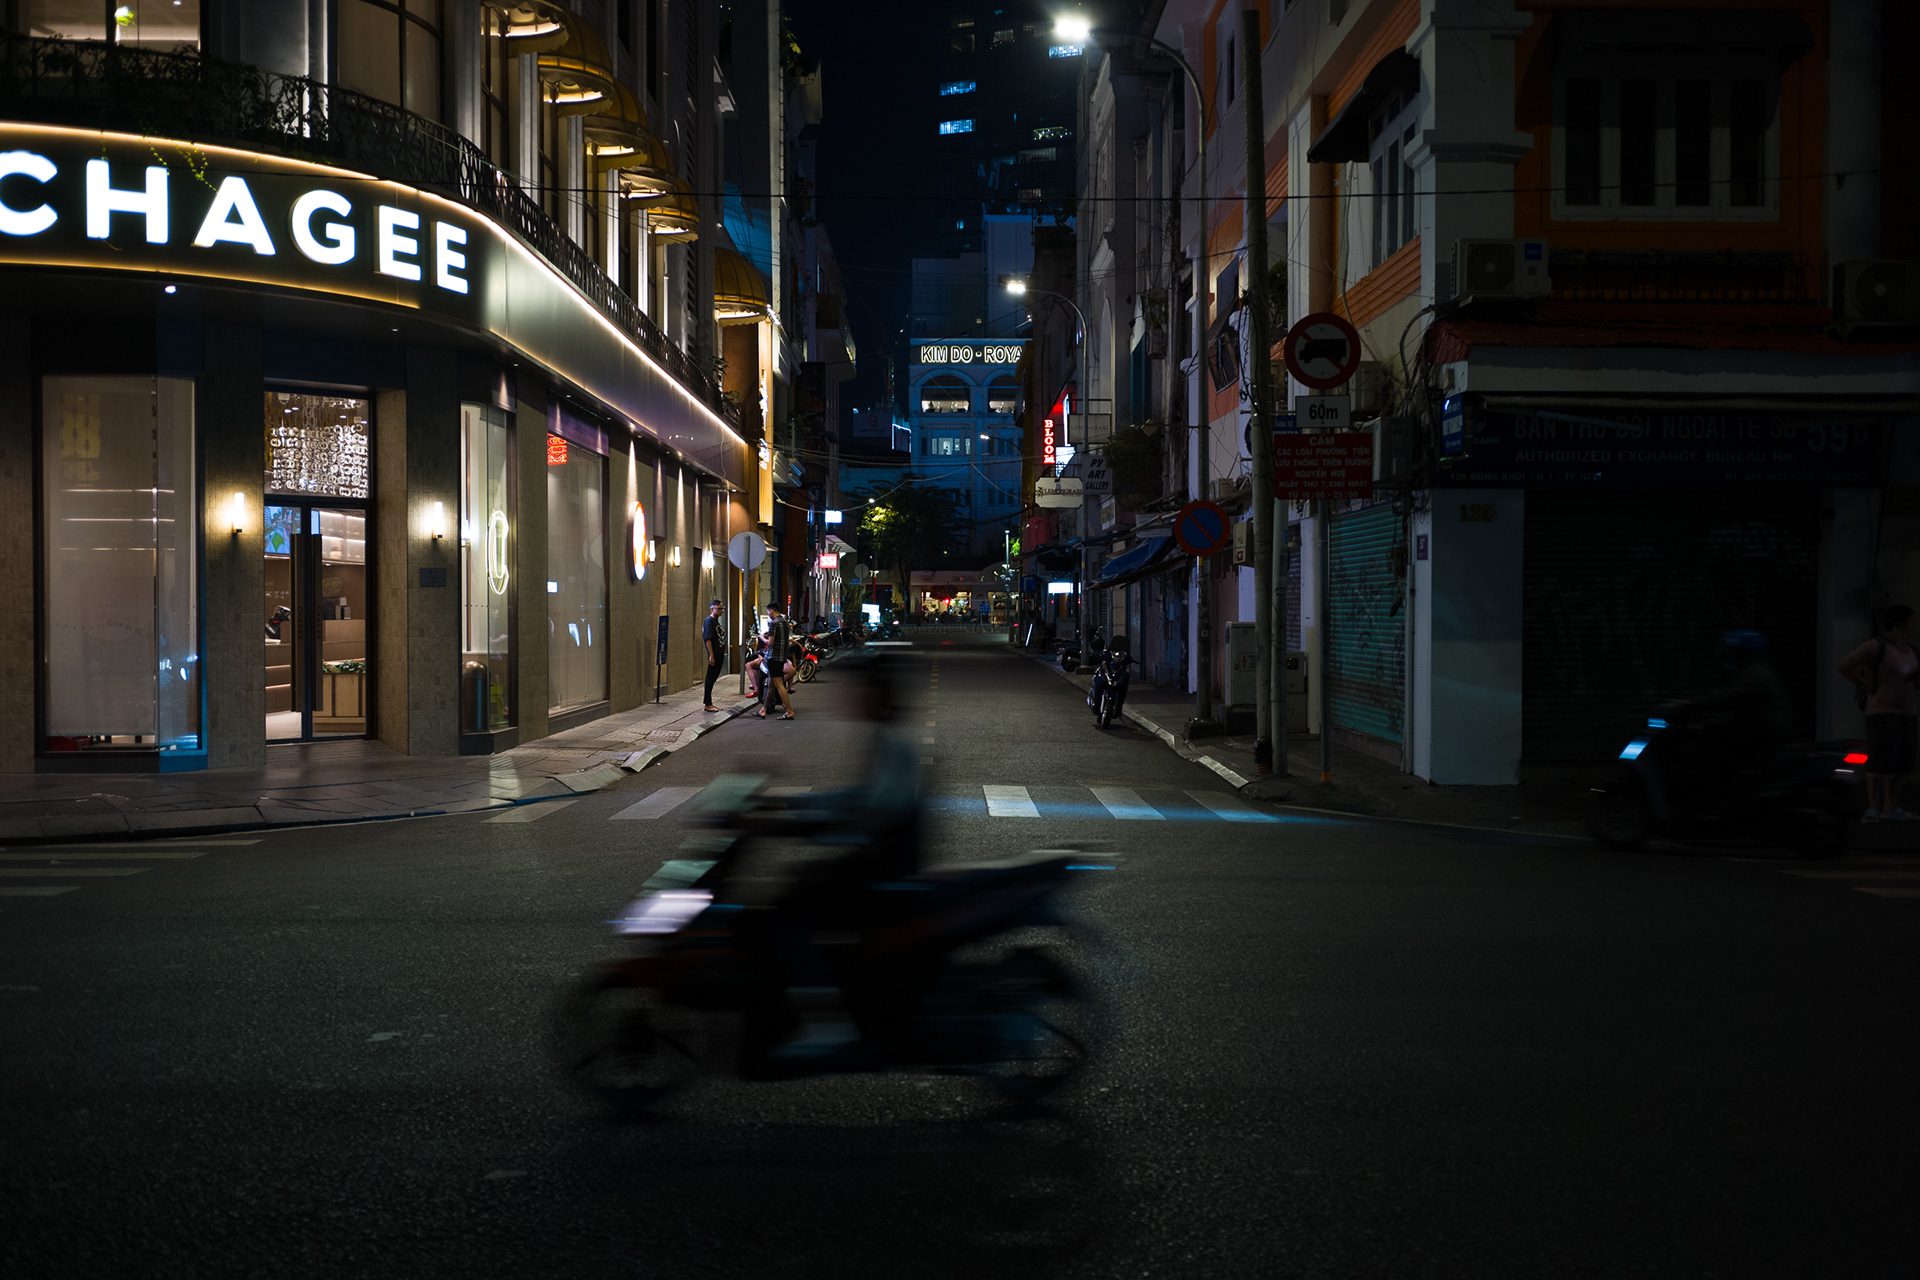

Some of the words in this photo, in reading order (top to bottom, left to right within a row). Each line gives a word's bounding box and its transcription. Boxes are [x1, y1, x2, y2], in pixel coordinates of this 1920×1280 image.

[0, 150, 470, 295] CHAGEE
[920, 346, 948, 363] KIM
[951, 346, 973, 364] DO
[1309, 403, 1339, 420] 60m
[1043, 419, 1056, 464] BLOOM
[1514, 450, 1611, 463] AUTHORIZED
[1617, 450, 1701, 463] EXCHANGE
[1706, 450, 1767, 463] BUREAU
[1090, 458, 1104, 468] PY
[1088, 470, 1107, 479] ART
[1450, 472, 1467, 481] 135
[1085, 481, 1110, 491] GALLERY
[820, 555, 837, 567] SSI
